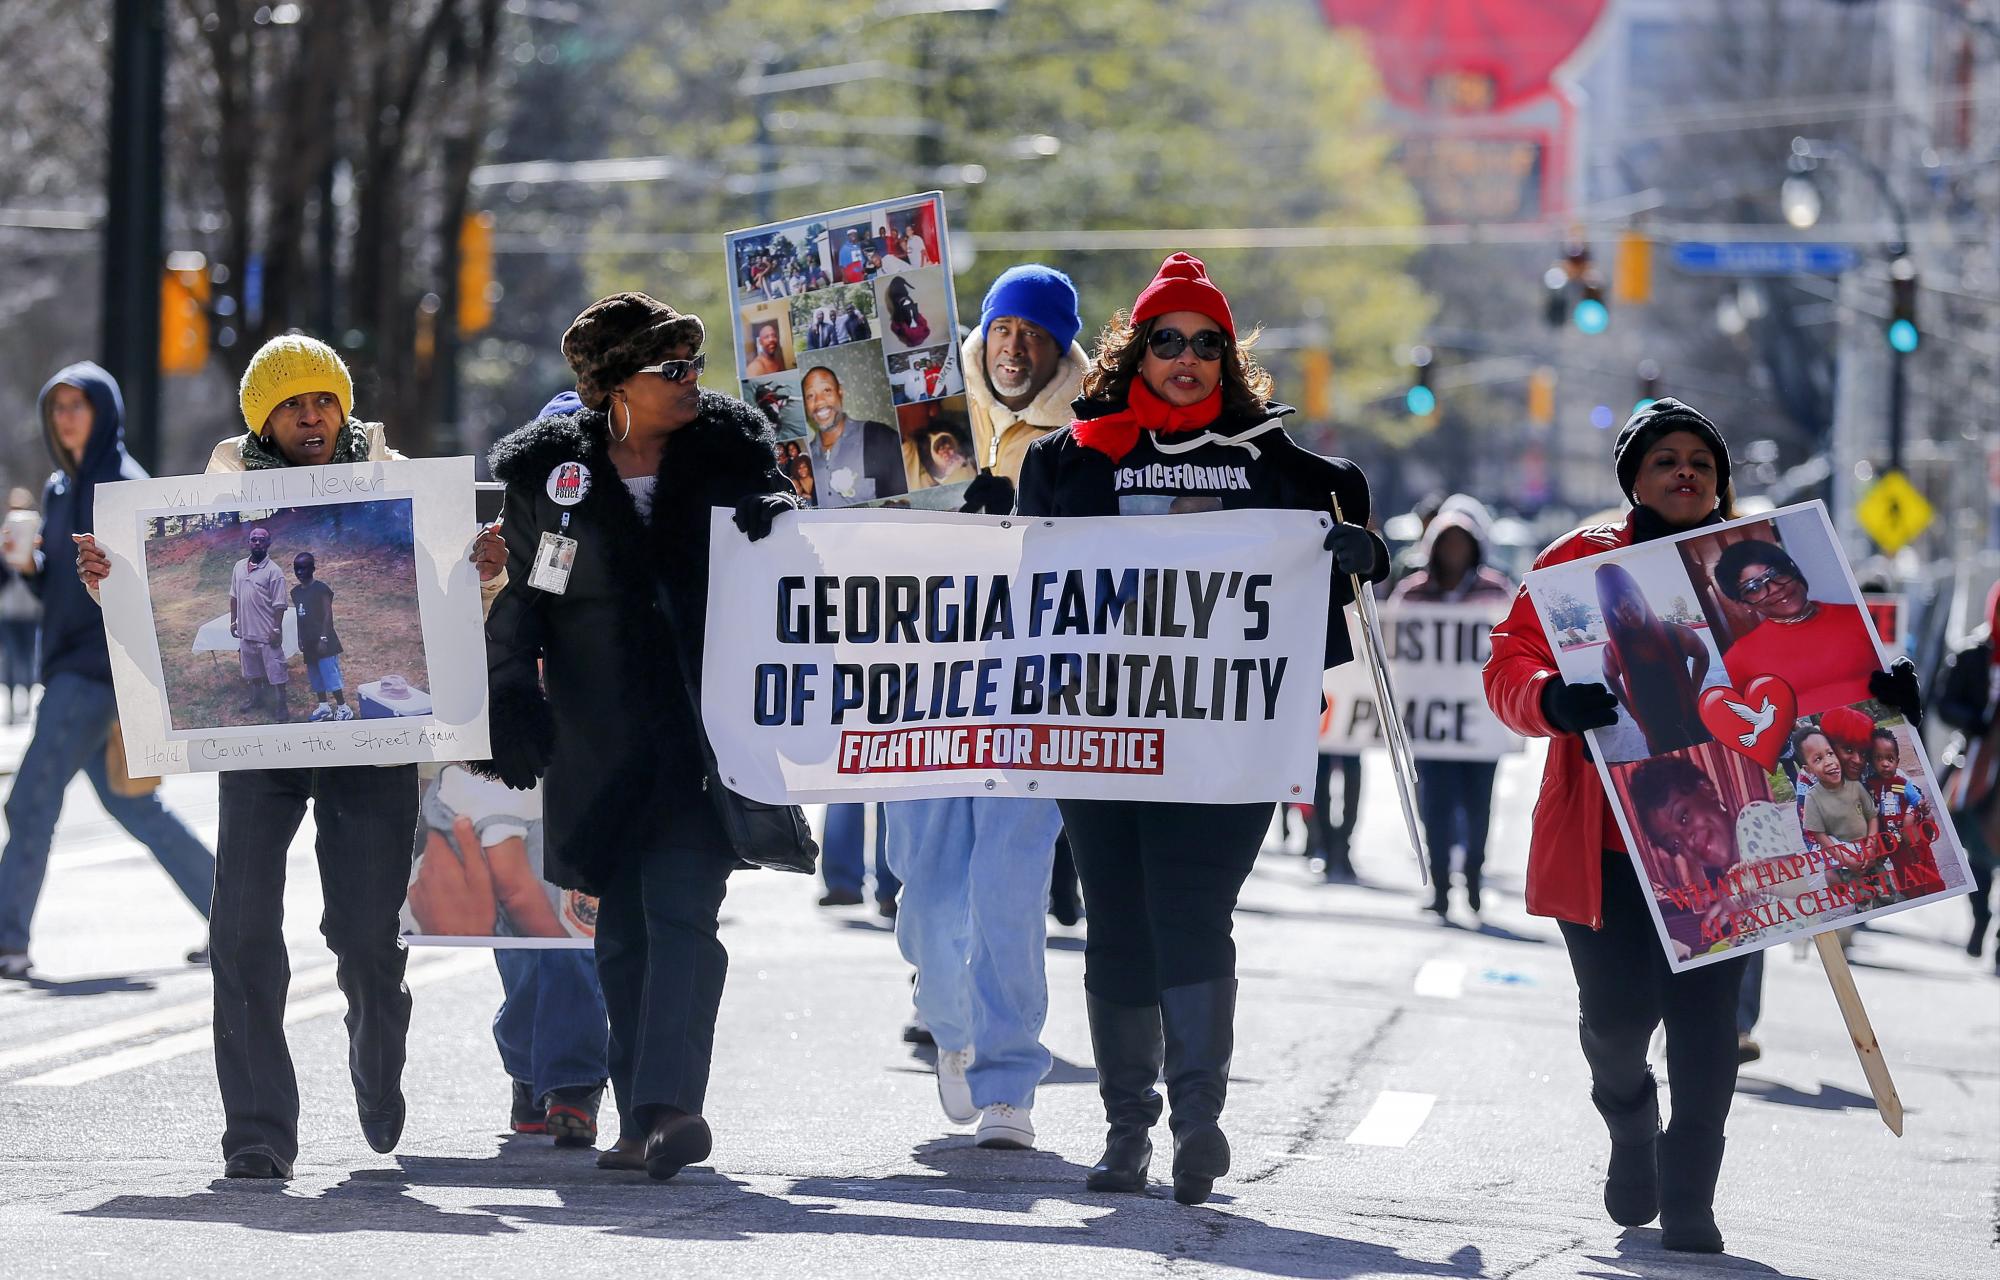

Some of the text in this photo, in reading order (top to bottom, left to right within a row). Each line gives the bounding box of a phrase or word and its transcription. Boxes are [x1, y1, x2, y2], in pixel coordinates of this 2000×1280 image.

[231, 475, 286, 504] Will
[309, 467, 387, 498] Never
[555, 490, 579, 499] POLICE
[1113, 462, 1252, 492] USTICEFORNICK
[775, 568, 1273, 645] GEORGIA FAMILY'S
[1378, 620, 1492, 664] USTIC
[753, 662, 819, 727] OF
[830, 657, 1003, 726] POLICE
[1010, 652, 1289, 722] BRUTALITY
[1346, 698, 1474, 744] PACE
[143, 744, 183, 767] Hold
[200, 738, 265, 760] Court
[301, 735, 337, 752] the
[351, 729, 412, 749] Street
[842, 727, 1159, 770] FIGHTING FOR JUSTICE
[1666, 820, 1942, 913] WHAT HAPPENED TO
[1699, 861, 1942, 945] ALEXIA CHRISTIAN
